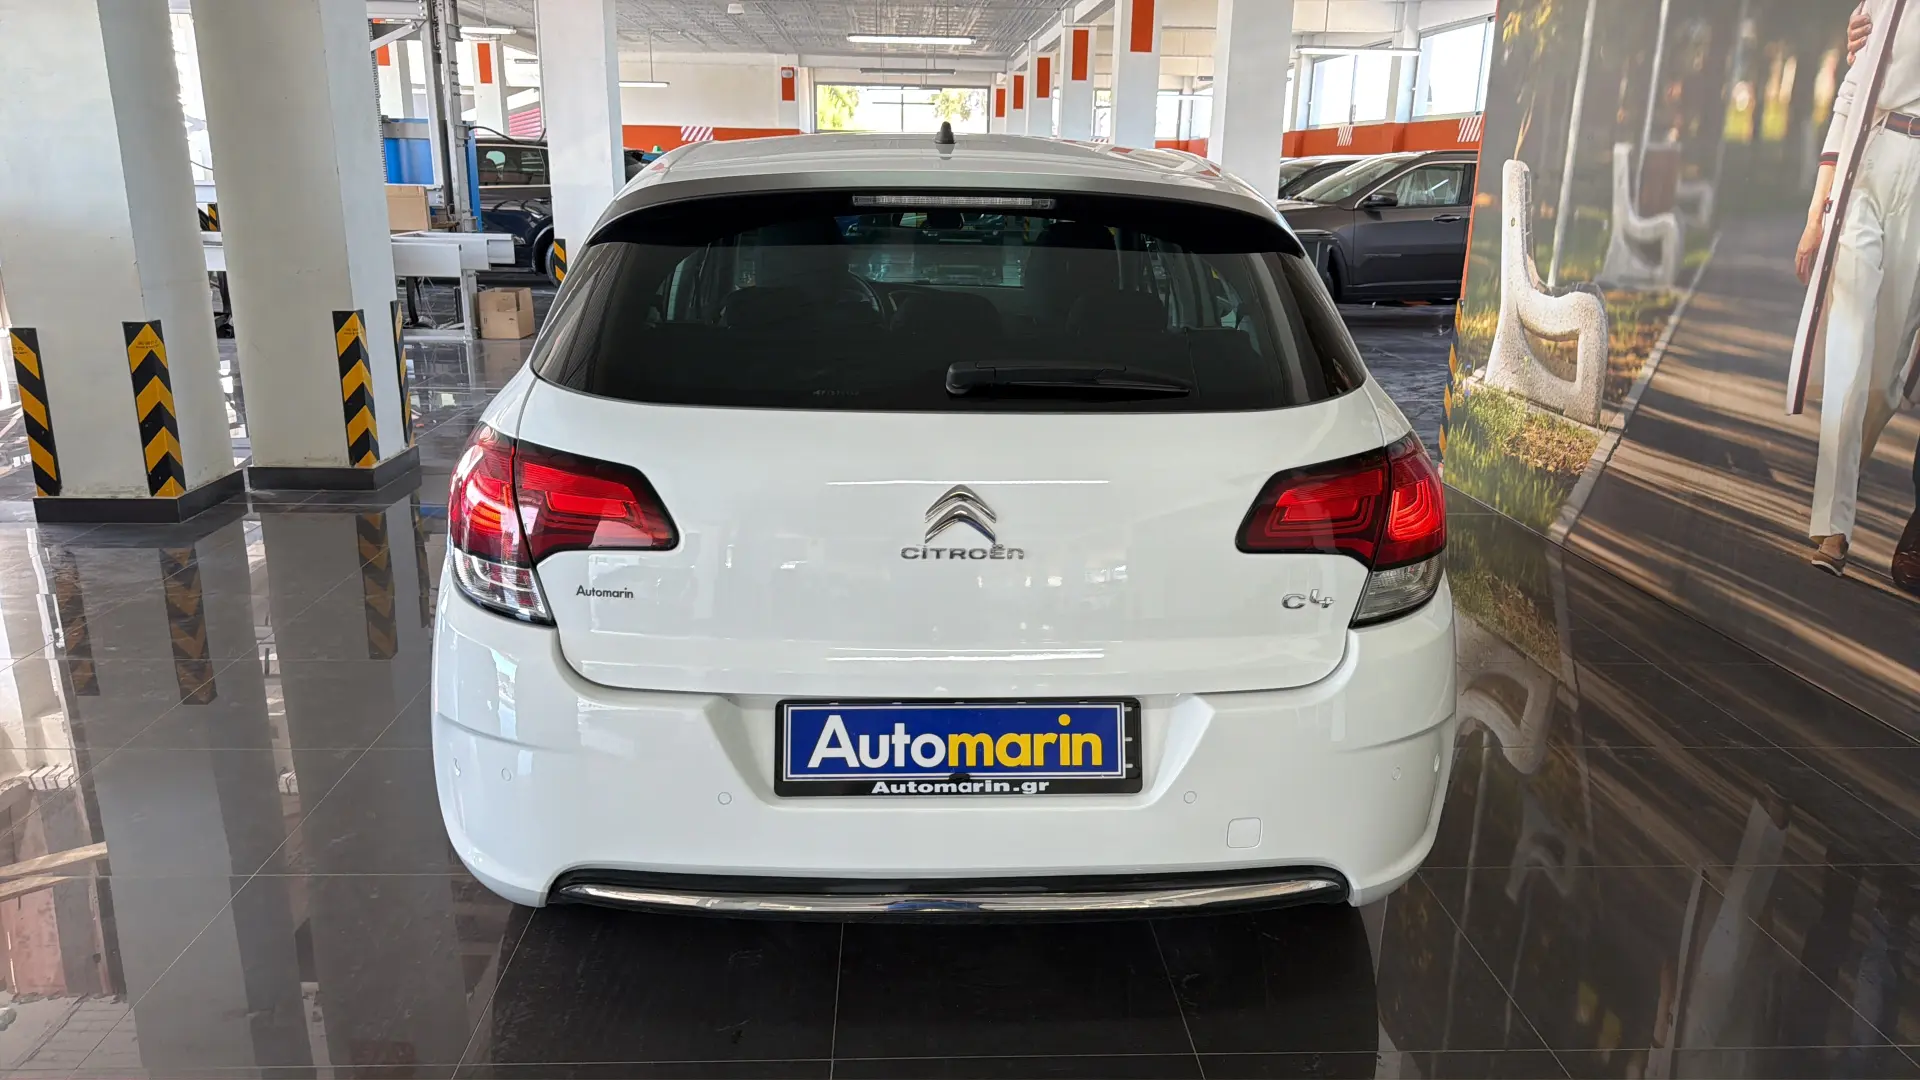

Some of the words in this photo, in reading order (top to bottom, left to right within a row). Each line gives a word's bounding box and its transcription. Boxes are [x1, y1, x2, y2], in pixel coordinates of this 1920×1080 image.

[576, 584, 634, 599] Automarin
[1281, 588, 1335, 609] C4
[806, 714, 1103, 769] Automarin
[871, 779, 1050, 795] Automarin.gr
